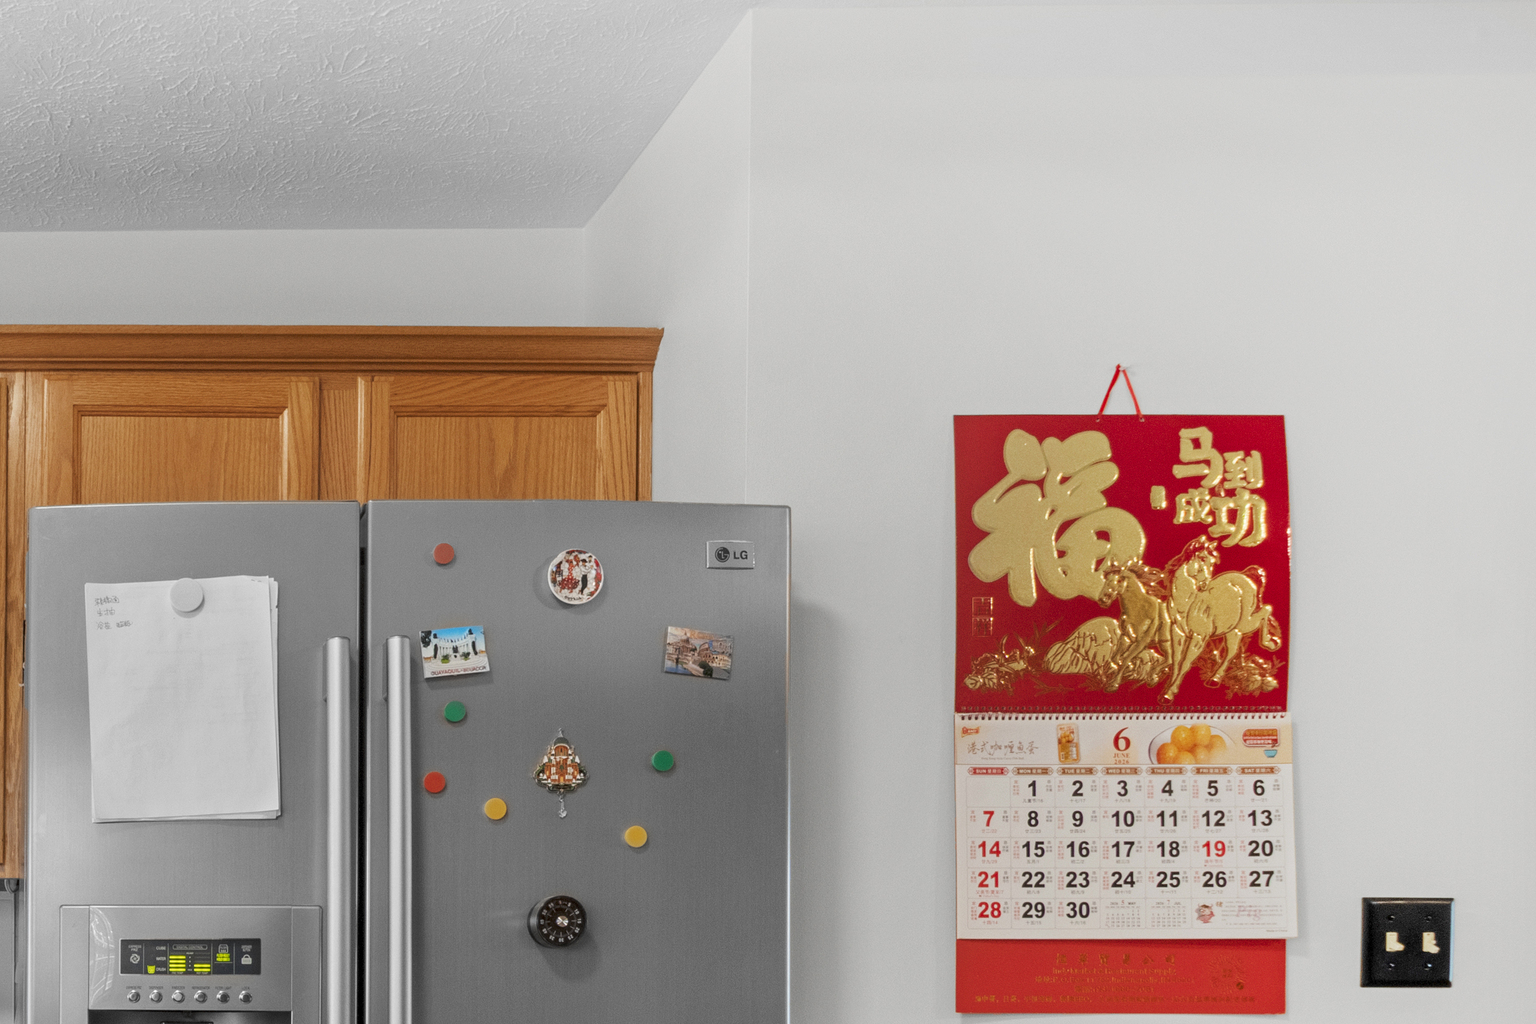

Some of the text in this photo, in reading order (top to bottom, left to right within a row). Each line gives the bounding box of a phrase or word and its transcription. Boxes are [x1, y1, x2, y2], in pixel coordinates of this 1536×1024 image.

[968, 428, 1146, 607] 福
[733, 550, 748, 560] LG
[1113, 726, 1131, 752] 6
[1028, 780, 1036, 796] 1
[1072, 780, 1083, 796] 2
[1118, 780, 1128, 796] 3
[1162, 780, 1173, 796] 4
[1208, 780, 1218, 796] 5
[1254, 780, 1264, 796] 6
[984, 811, 994, 827] 7
[1028, 811, 1038, 827] 8
[1072, 811, 1083, 827] 9
[1112, 811, 1134, 827] 10
[1157, 811, 1177, 827] 11
[1202, 811, 1225, 827] 12
[1248, 811, 1272, 827] 13
[979, 841, 1001, 857] 14
[1022, 841, 1045, 857] 15
[1067, 841, 1089, 857] 16
[1112, 841, 1134, 857] 17
[1157, 841, 1179, 857] 18
[1203, 841, 1225, 857] 19
[1249, 841, 1273, 857] 20
[978, 871, 998, 887] 21
[1022, 871, 1045, 887] 22
[1066, 871, 1089, 887] 23
[1111, 871, 1135, 887] 24
[1157, 871, 1180, 887] 25
[1203, 871, 1226, 887] 26
[1250, 871, 1274, 887] 27
[978, 902, 1001, 918] 28
[1022, 902, 1045, 918] 29
[1066, 902, 1089, 918] 30
